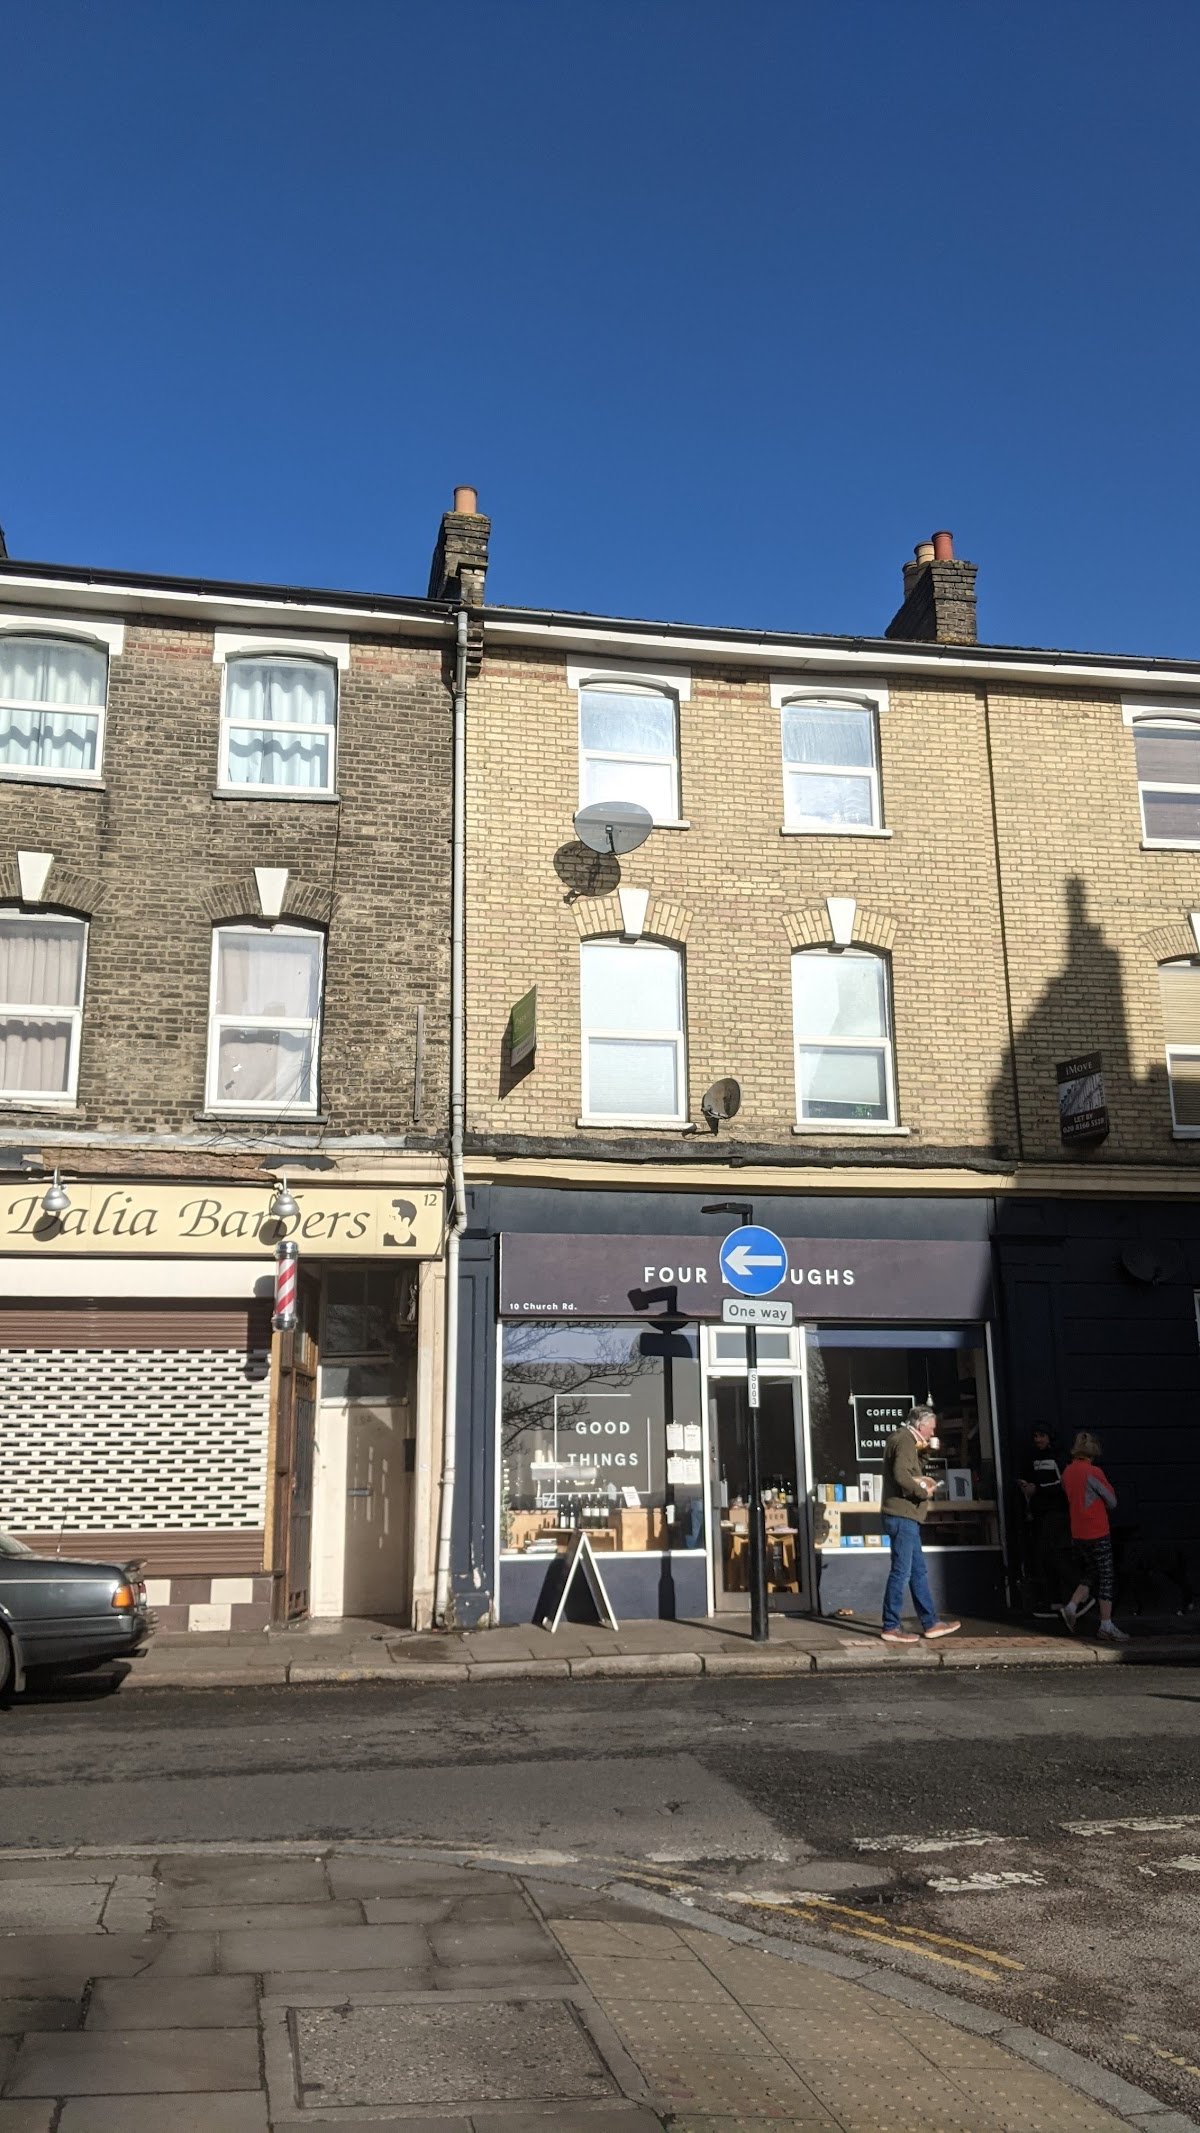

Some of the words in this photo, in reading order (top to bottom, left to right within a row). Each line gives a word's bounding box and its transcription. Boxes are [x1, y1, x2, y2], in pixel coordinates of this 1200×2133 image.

[424, 1194, 437, 1206] 12
[7, 1191, 158, 1236] Dalia
[644, 1267, 708, 1283] FOUR
[523, 1302, 558, 1310] Church
[562, 1302, 578, 1310] Rd.
[728, 1304, 756, 1318] One
[760, 1309, 788, 1321] way
[866, 1409, 903, 1417] COFFEE
[575, 1421, 630, 1435] GOOD
[873, 1424, 897, 1432] BEER
[860, 1440, 887, 1448] KOMB
[567, 1452, 639, 1466] THINGS
